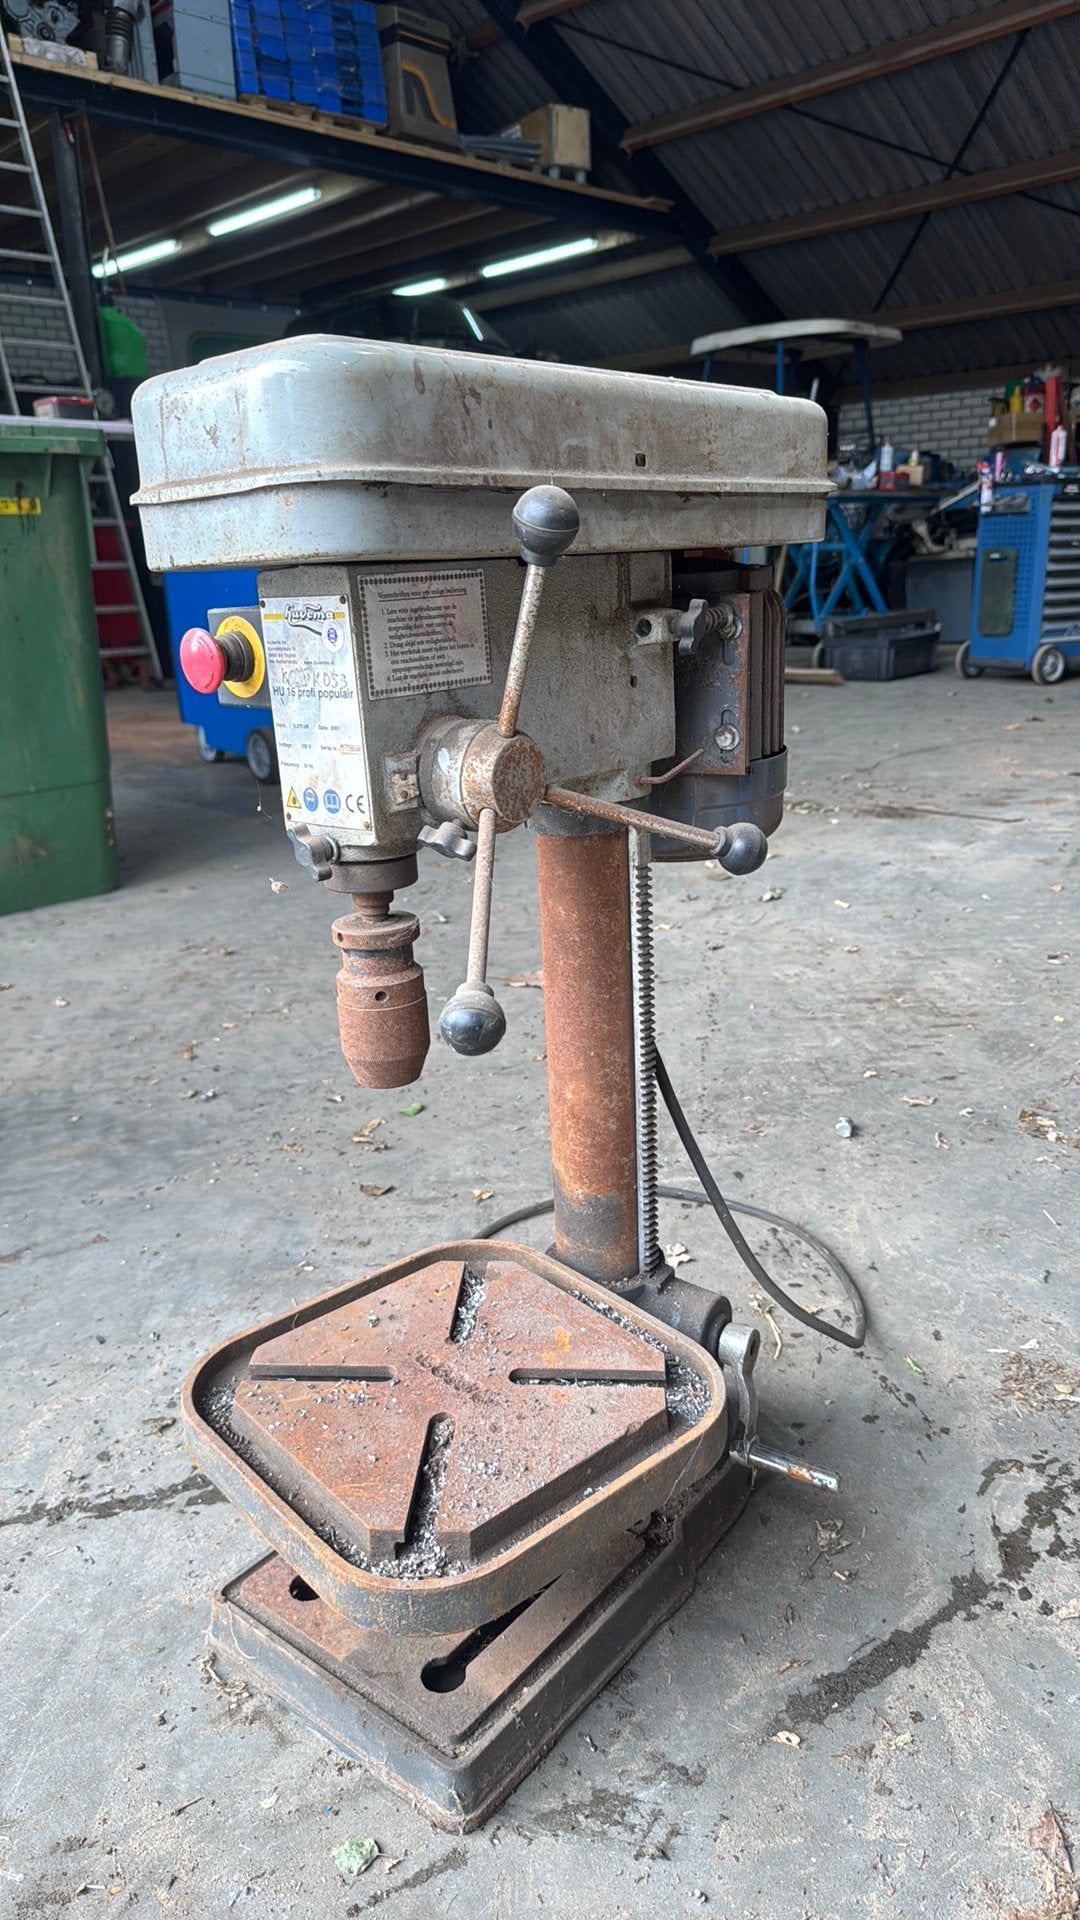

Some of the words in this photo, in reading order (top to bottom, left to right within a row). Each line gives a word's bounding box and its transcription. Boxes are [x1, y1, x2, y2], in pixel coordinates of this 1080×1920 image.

[378, 590, 410, 599] Voorschriften
[272, 686, 285, 696] HU
[287, 687, 296, 696] 16
[298, 687, 316, 700] profi
[318, 687, 353, 700] populair
[346, 794, 366, 814] CE
